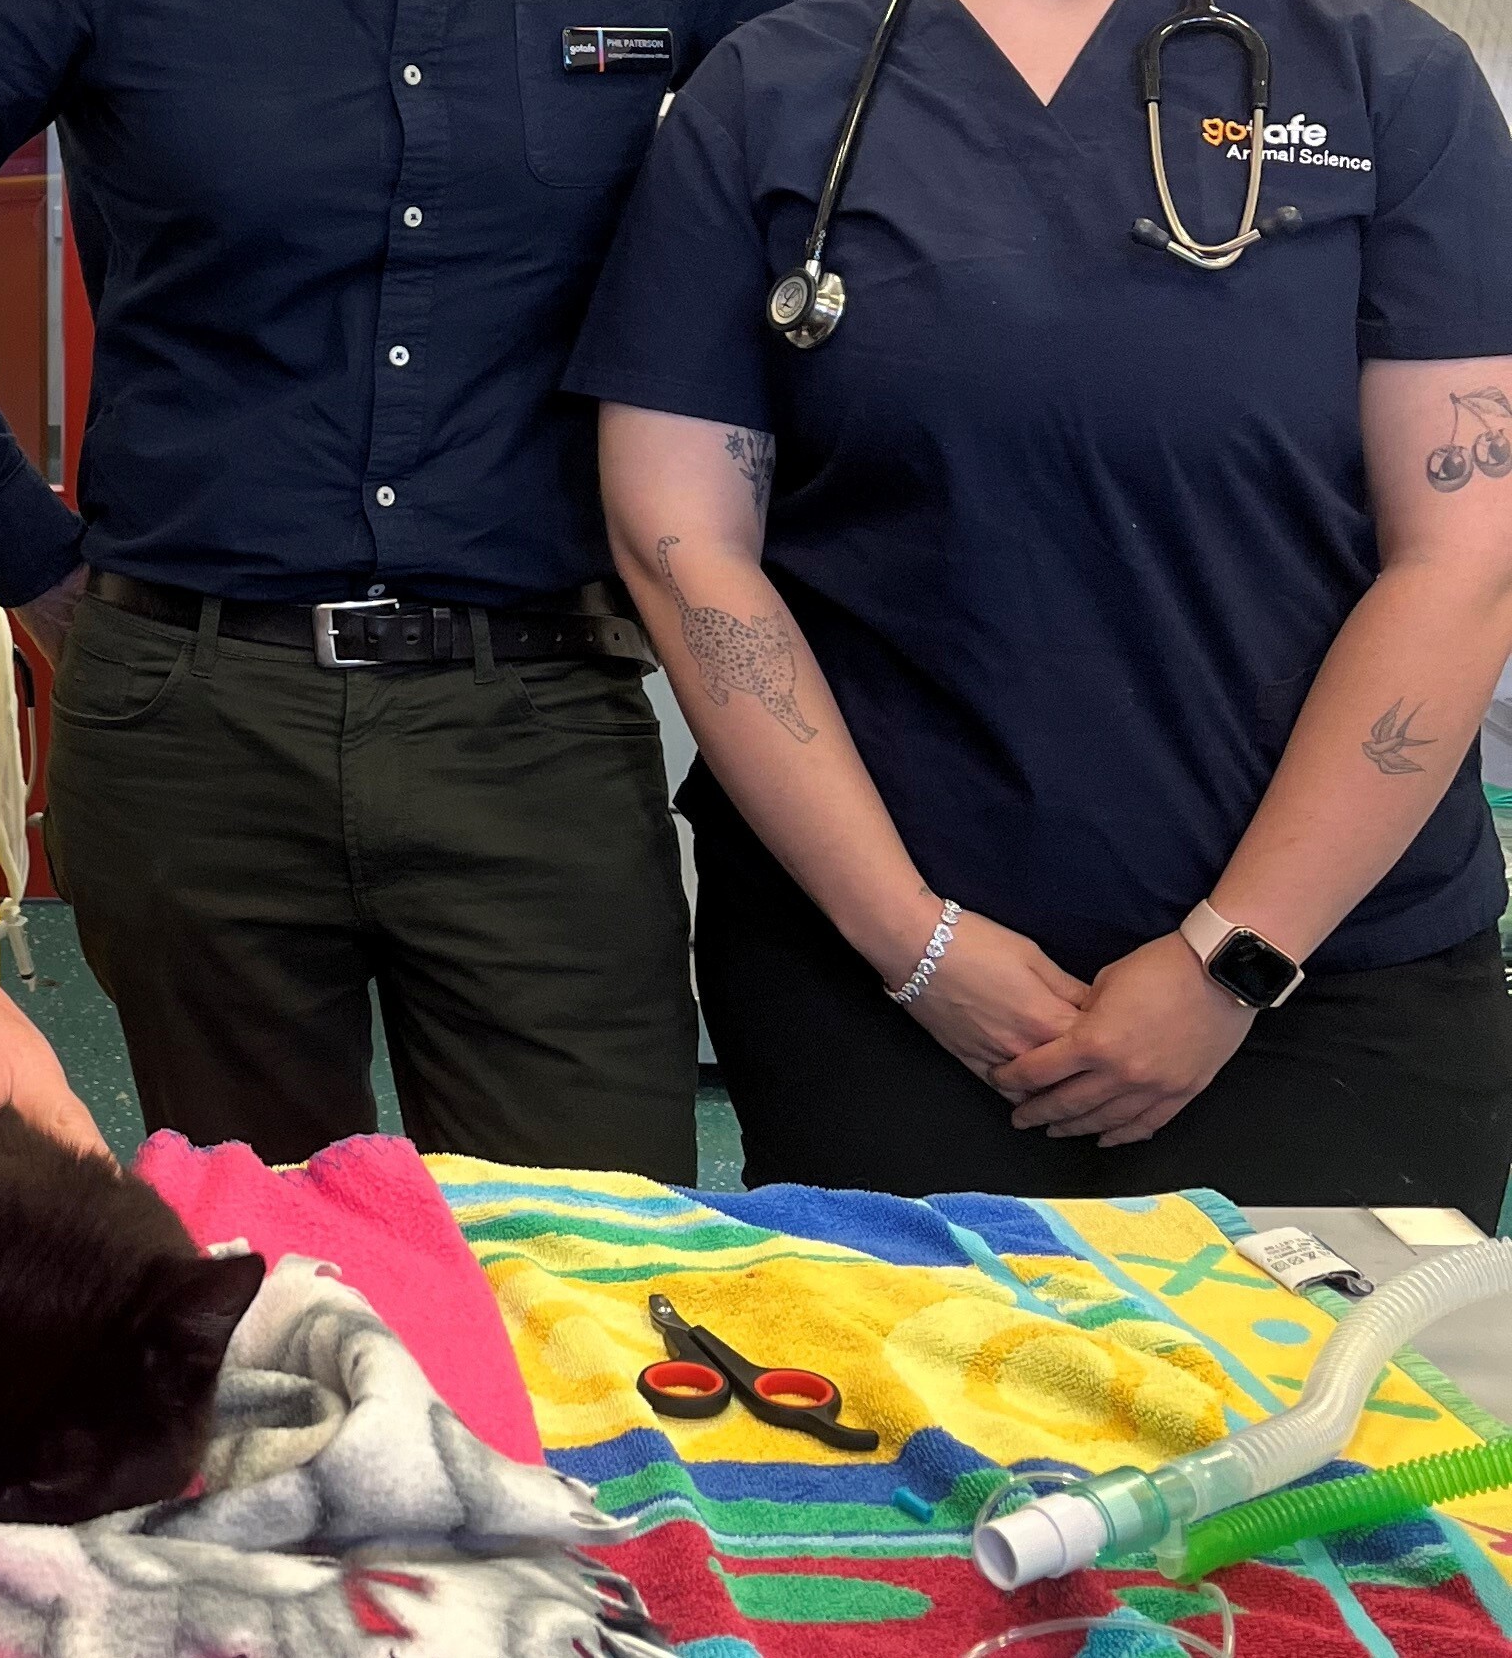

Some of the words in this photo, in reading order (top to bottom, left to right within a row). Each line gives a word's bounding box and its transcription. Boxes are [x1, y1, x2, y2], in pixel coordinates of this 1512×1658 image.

[569, 42, 596, 56] gotafe
[1225, 143, 1295, 163] Anmal
[1298, 148, 1373, 172] Science
